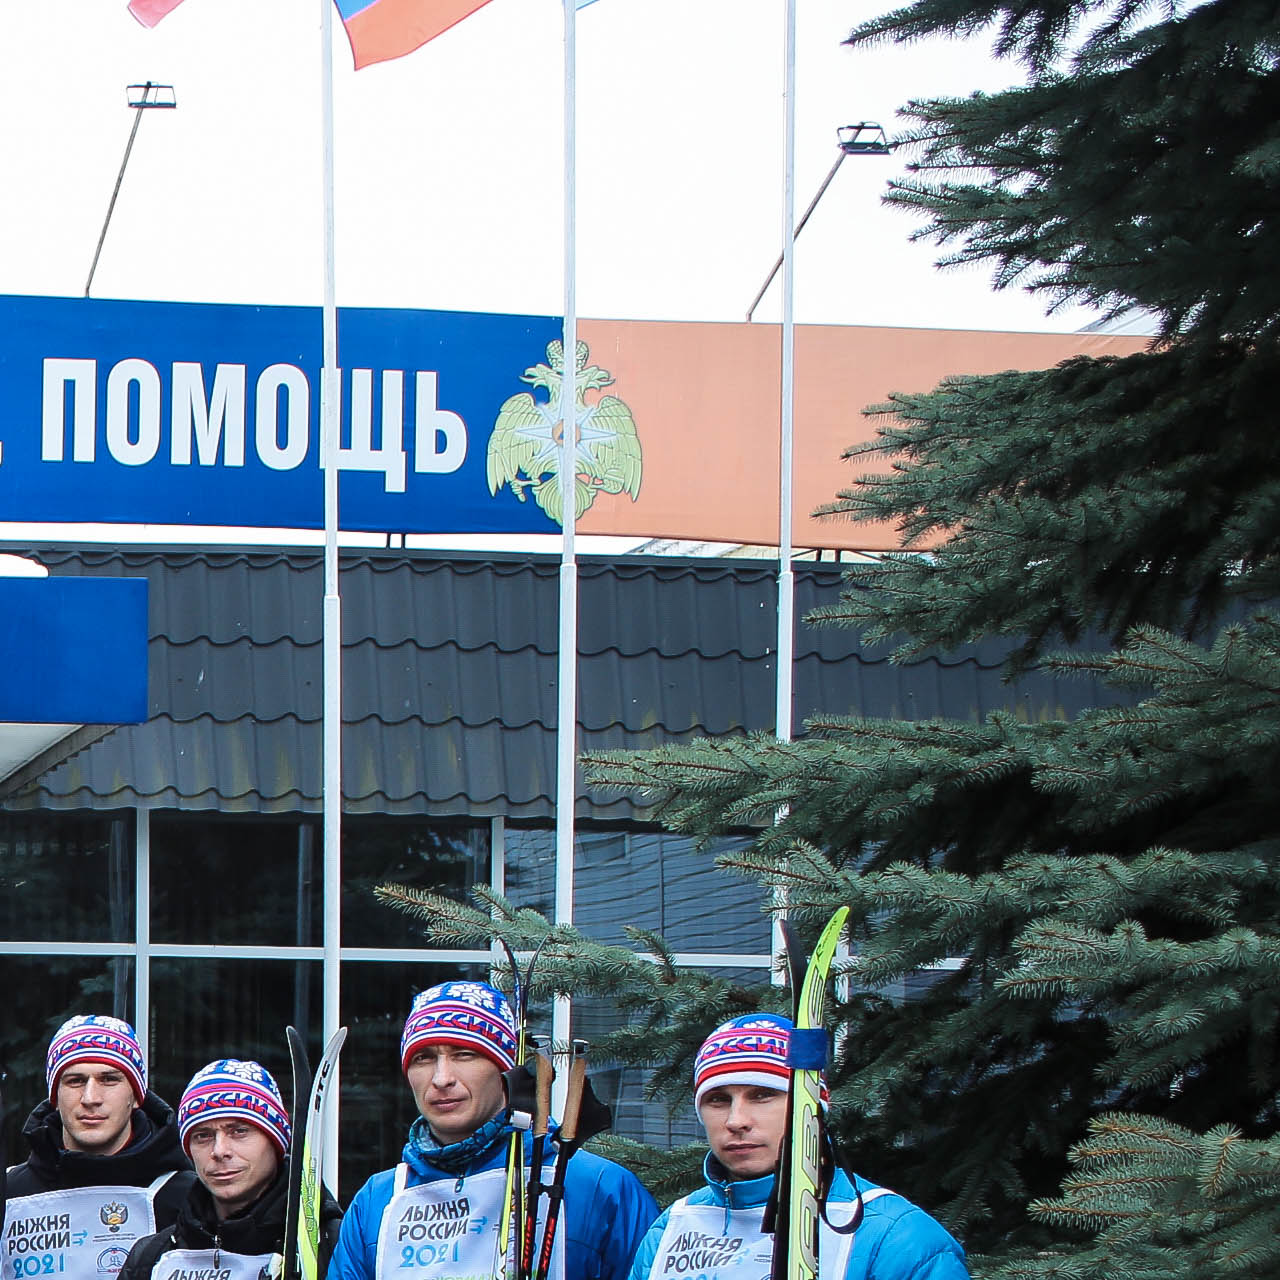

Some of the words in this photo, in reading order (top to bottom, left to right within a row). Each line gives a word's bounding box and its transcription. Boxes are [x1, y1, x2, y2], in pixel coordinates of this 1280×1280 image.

[40, 356, 468, 493] ПОМОЩЬ
[313, 1060, 331, 1113] STC
[402, 1197, 470, 1223] ЛЫЖНЯ
[7, 1214, 70, 1238] ЛЫЖНЯ
[398, 1221, 468, 1242] РОССИИ
[8, 1232, 70, 1255] РОССИИ
[668, 1231, 743, 1254] ЛЫЖНЯ
[13, 1255, 65, 1279] 2021
[399, 1242, 459, 1268] 2021
[664, 1249, 734, 1274] РОССИИ
